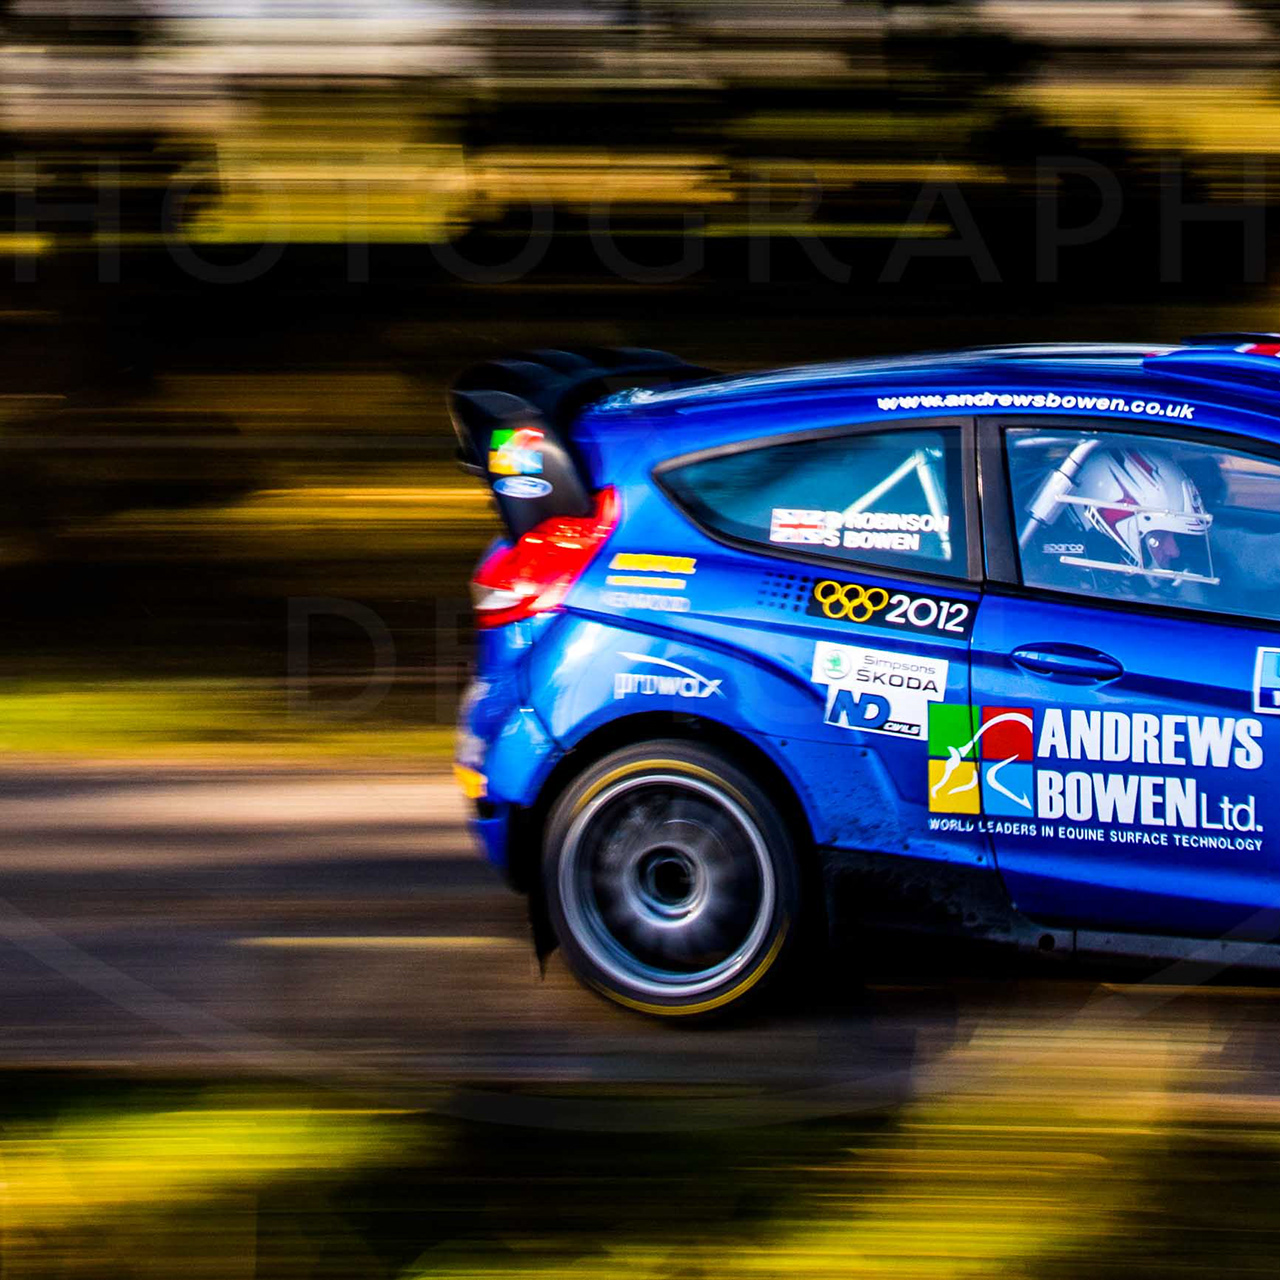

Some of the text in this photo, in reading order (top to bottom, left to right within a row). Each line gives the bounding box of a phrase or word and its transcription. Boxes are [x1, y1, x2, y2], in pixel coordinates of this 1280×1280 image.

[876, 391, 1196, 420] www.andrewsbowen.co.uk
[844, 511, 950, 533] ROBINSON
[843, 531, 920, 551] BOWEN
[1042, 543, 1085, 554] sparco
[885, 594, 969, 632] 2012
[864, 655, 936, 675] Simpsons
[613, 673, 727, 699] prowax
[828, 688, 891, 729] ND
[1037, 708, 1264, 770] ANDREWS
[1037, 769, 1265, 833] BOWEN Ltd.
[928, 817, 1263, 853] WORLD LEADERS IN EQUINE SURFACE TECHNOLOGY
